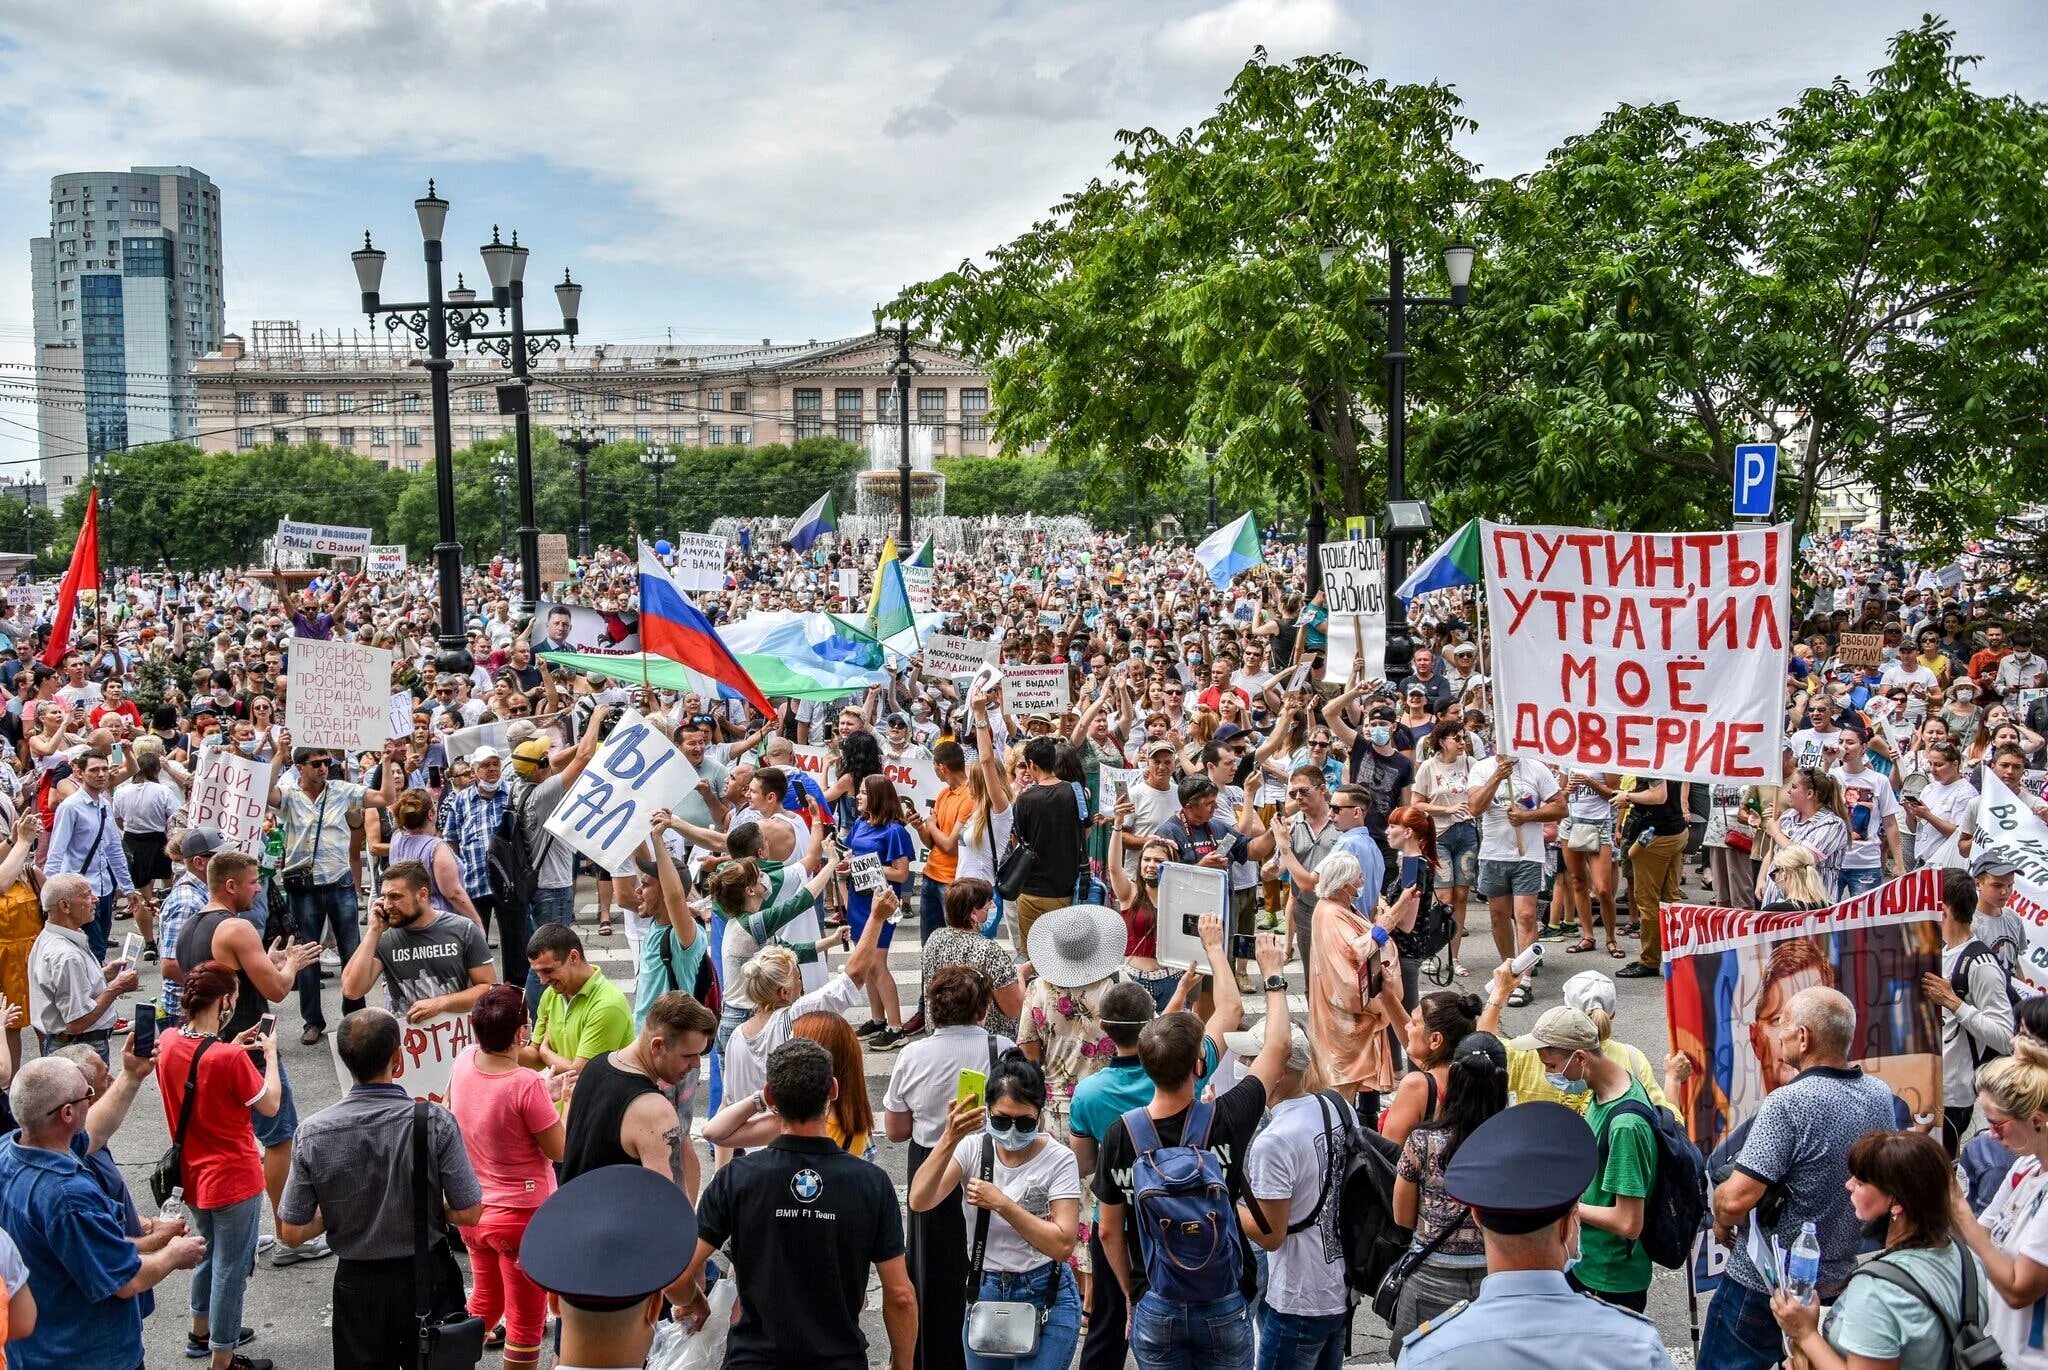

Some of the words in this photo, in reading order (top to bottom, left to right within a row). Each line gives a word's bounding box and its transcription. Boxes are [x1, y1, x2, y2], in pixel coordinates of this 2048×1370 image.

[1742, 453, 1766, 505] P
[283, 523, 318, 536] Сергей
[321, 527, 368, 540] Иванович
[328, 541, 365, 553] Вами!
[681, 536, 724, 550] ХАБАРОВСК
[683, 548, 721, 559] АМУРКА
[1358, 540, 1379, 570] ВОН
[681, 558, 687, 568] С
[692, 559, 721, 571] ВАМИ
[1503, 588, 1783, 651] УТРАТИЛ
[947, 639, 967, 650] НЕТ
[1841, 634, 1879, 646] СВОБОДУ
[296, 643, 374, 664] ПРОСНИСЬ
[314, 660, 365, 678] НАРОД
[295, 672, 372, 691] ПРОСНИСЬ
[1011, 679, 1023, 688] НЕ
[1561, 653, 1708, 713] МОЁ
[304, 687, 362, 704] СТРАНА
[295, 701, 333, 717] ВЕДЬ
[343, 704, 381, 720] ВАМИ
[1012, 700, 1024, 709] НЕ
[302, 715, 360, 731] ПРАВИТ
[302, 730, 361, 745] САТАНА
[1513, 702, 1765, 778] ДОВЕРИЕ
[198, 757, 252, 792] ОЛОЙ
[392, 948, 410, 962] LOS
[412, 942, 459, 961] ANGELES
[775, 1208, 799, 1217] BMW
[802, 1209, 811, 1218] F1
[814, 1210, 836, 1221] Team
[973, 1241, 983, 1271] FASHION
